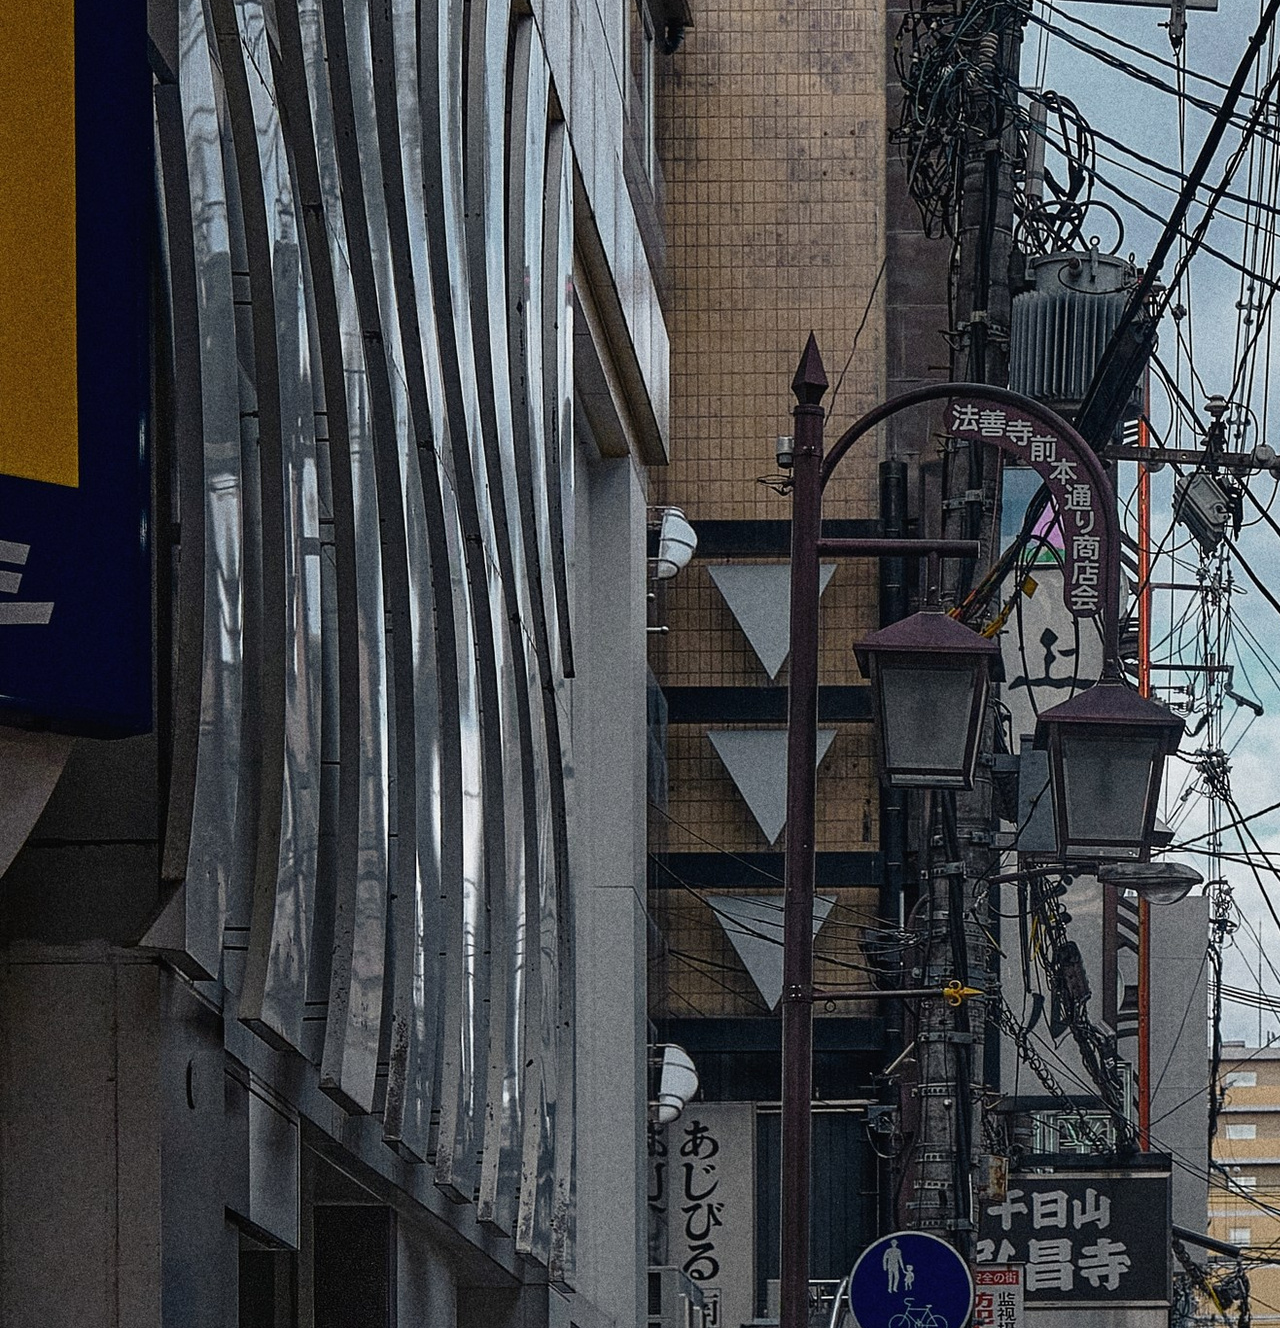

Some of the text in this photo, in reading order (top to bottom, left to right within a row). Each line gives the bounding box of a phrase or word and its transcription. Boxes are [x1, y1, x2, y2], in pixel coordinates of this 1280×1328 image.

[951, 404, 1103, 613] 法善寺前本通り商店会
[679, 1119, 725, 1281] あじびる
[986, 1187, 1111, 1231] 千日山
